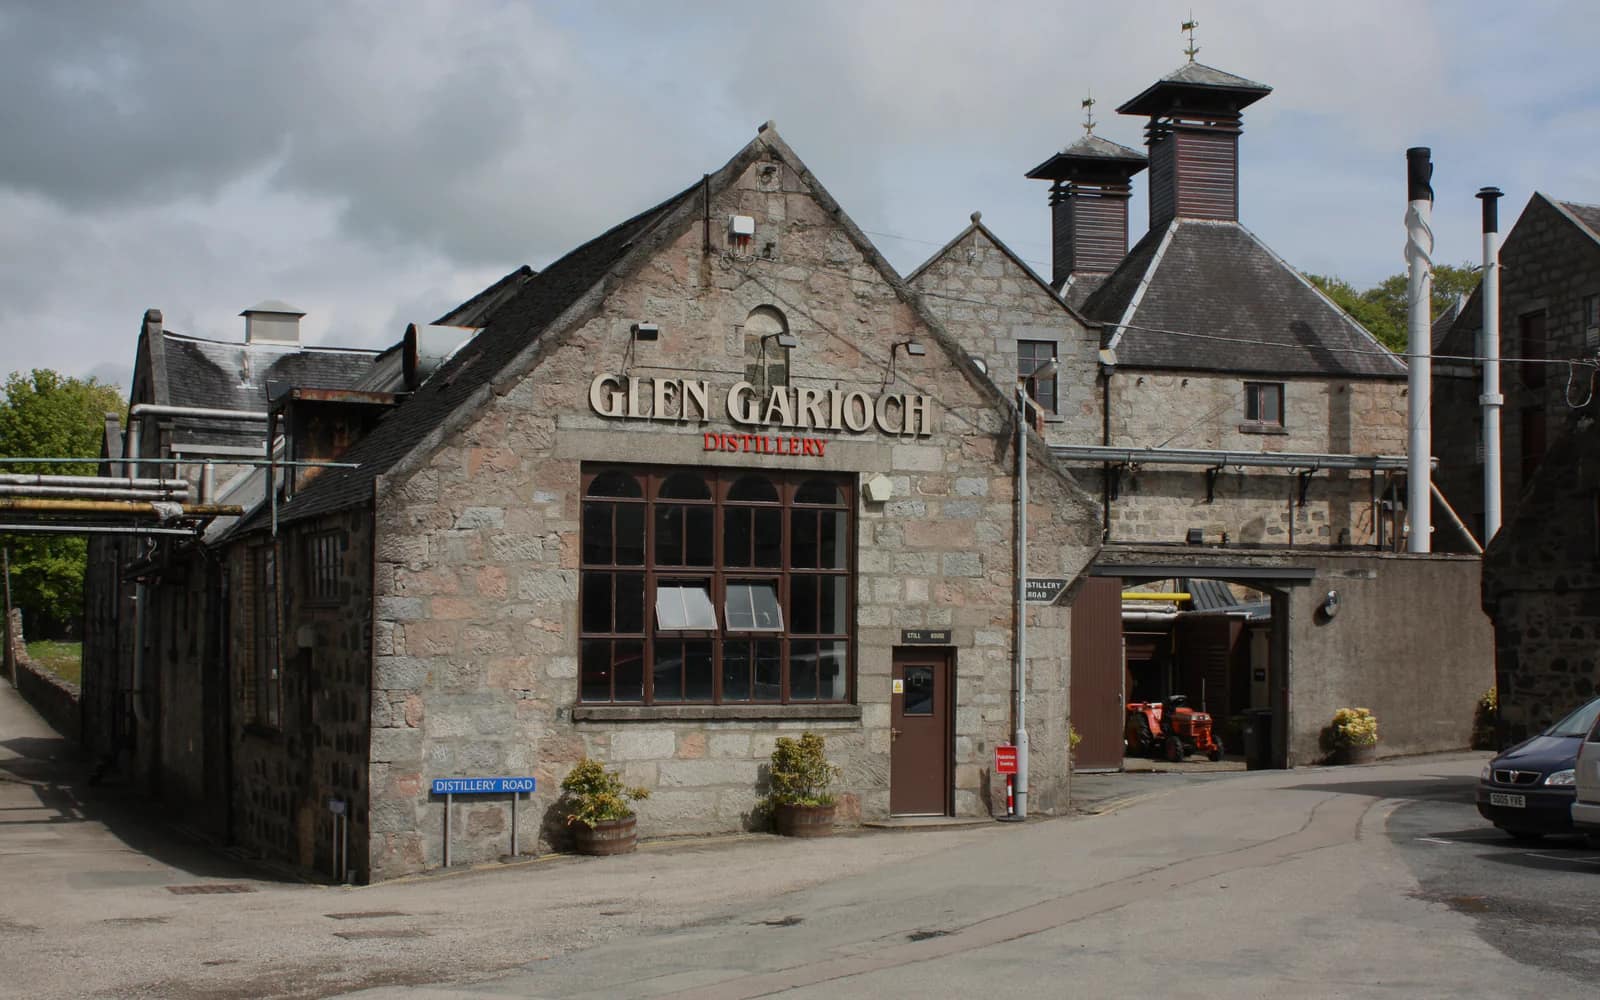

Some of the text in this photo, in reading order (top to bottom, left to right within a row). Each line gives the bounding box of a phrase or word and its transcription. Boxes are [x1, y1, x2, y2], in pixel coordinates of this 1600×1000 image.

[590, 372, 933, 436] GLEN GARIOCH
[703, 432, 828, 457] DISTILLERY
[1024, 581, 1062, 589] ISTILLERY
[1027, 591, 1047, 599] ROAD
[436, 780, 533, 791] DISTILLERY ROAD
